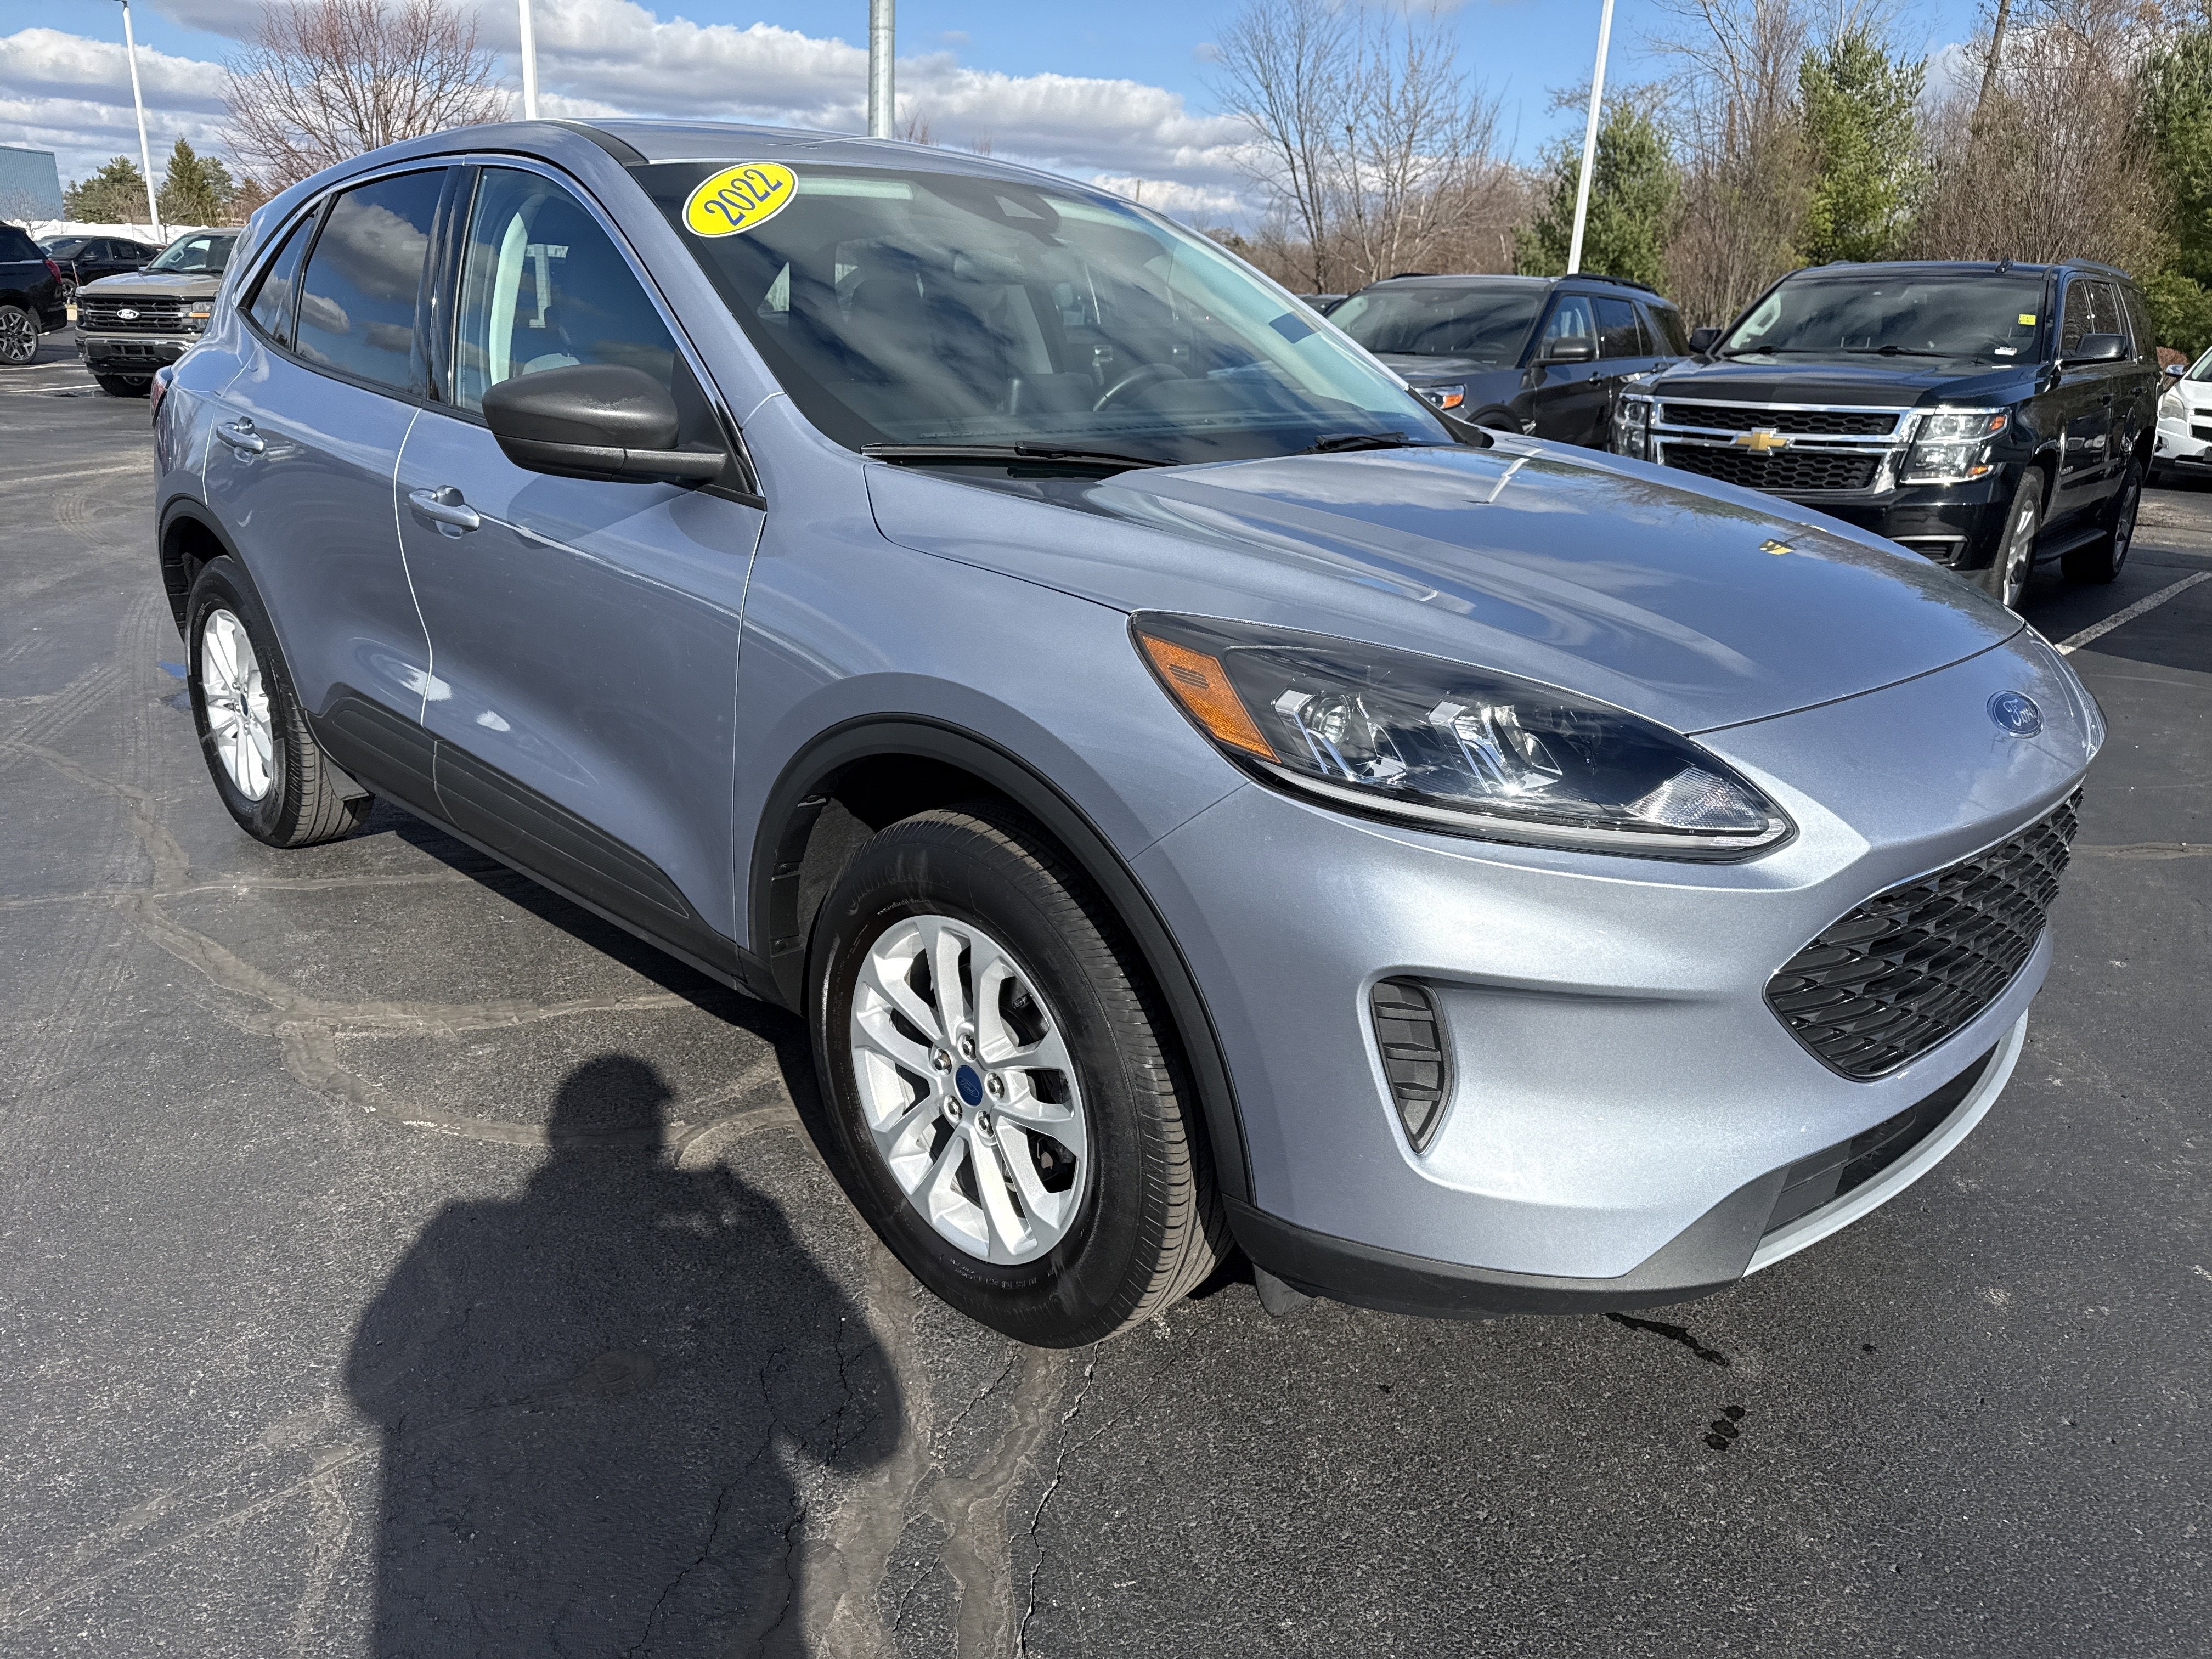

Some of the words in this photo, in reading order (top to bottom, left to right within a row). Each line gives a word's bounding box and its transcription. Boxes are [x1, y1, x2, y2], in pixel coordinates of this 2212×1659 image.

[703, 168, 784, 227] 2022
[2002, 698, 2038, 727] Ford
[960, 1079, 976, 1095] Ford
